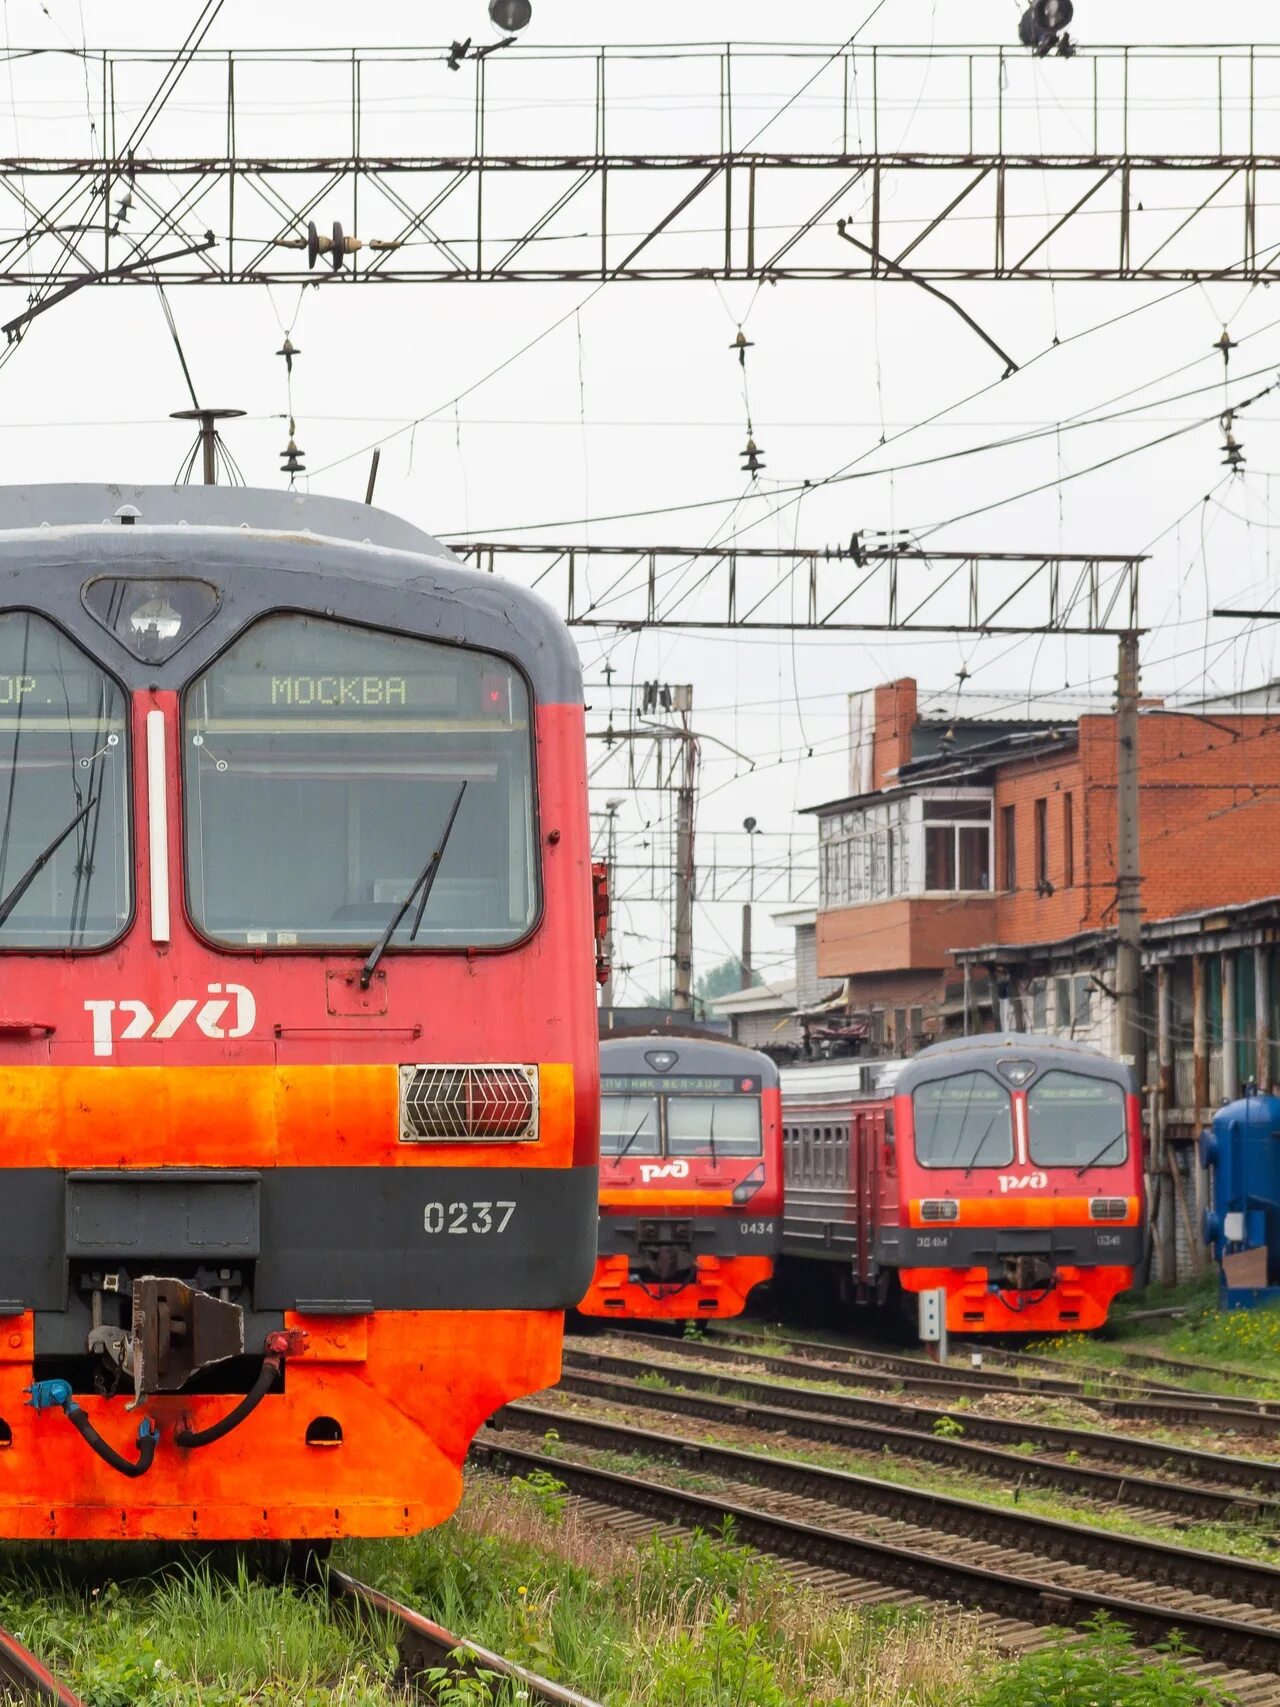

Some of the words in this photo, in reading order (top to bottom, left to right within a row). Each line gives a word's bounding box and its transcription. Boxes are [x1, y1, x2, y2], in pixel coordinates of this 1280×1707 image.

[271, 676, 406, 704] МОСКВА
[424, 1201, 516, 1234] 0237
[740, 1223, 773, 1234] 0434
